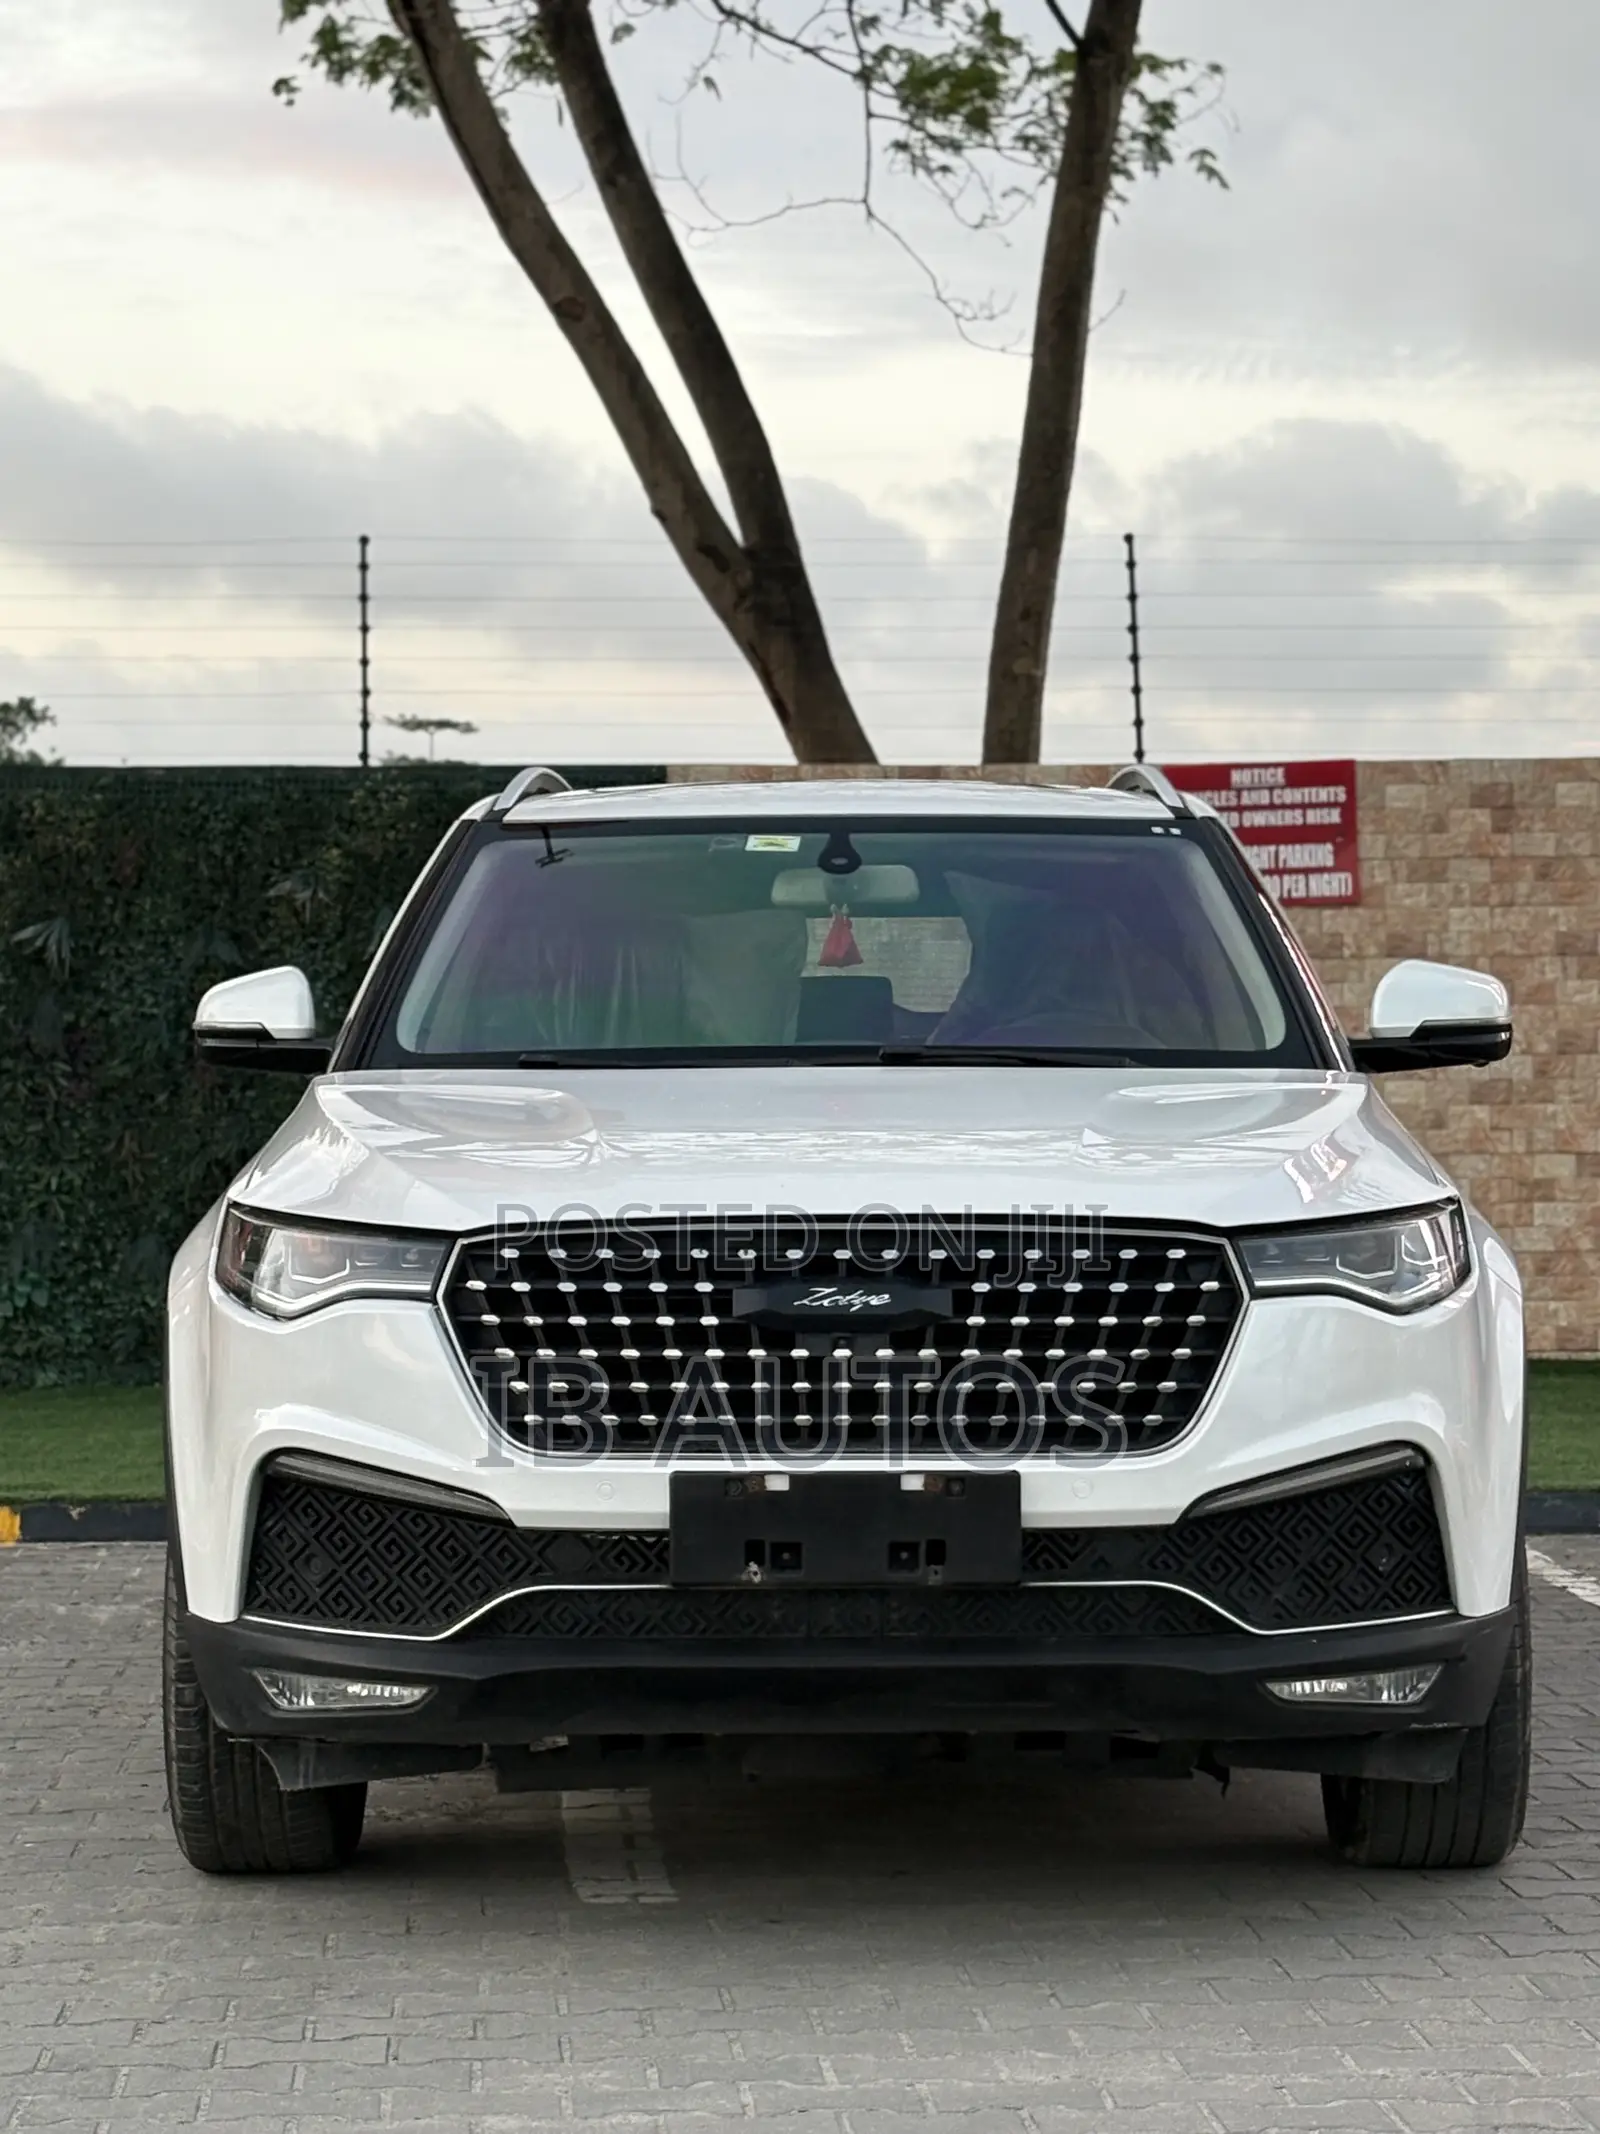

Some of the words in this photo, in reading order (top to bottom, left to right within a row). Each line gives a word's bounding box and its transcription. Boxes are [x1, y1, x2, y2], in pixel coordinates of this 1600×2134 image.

[1230, 767, 1286, 787] NOTICE
[1240, 788, 1270, 806] AND
[1272, 786, 1347, 804] CONTENTS
[1242, 809, 1304, 827] OWNERS
[1305, 807, 1342, 825] RISK
[1278, 843, 1334, 868] PARKING
[1282, 874, 1307, 898] PER
